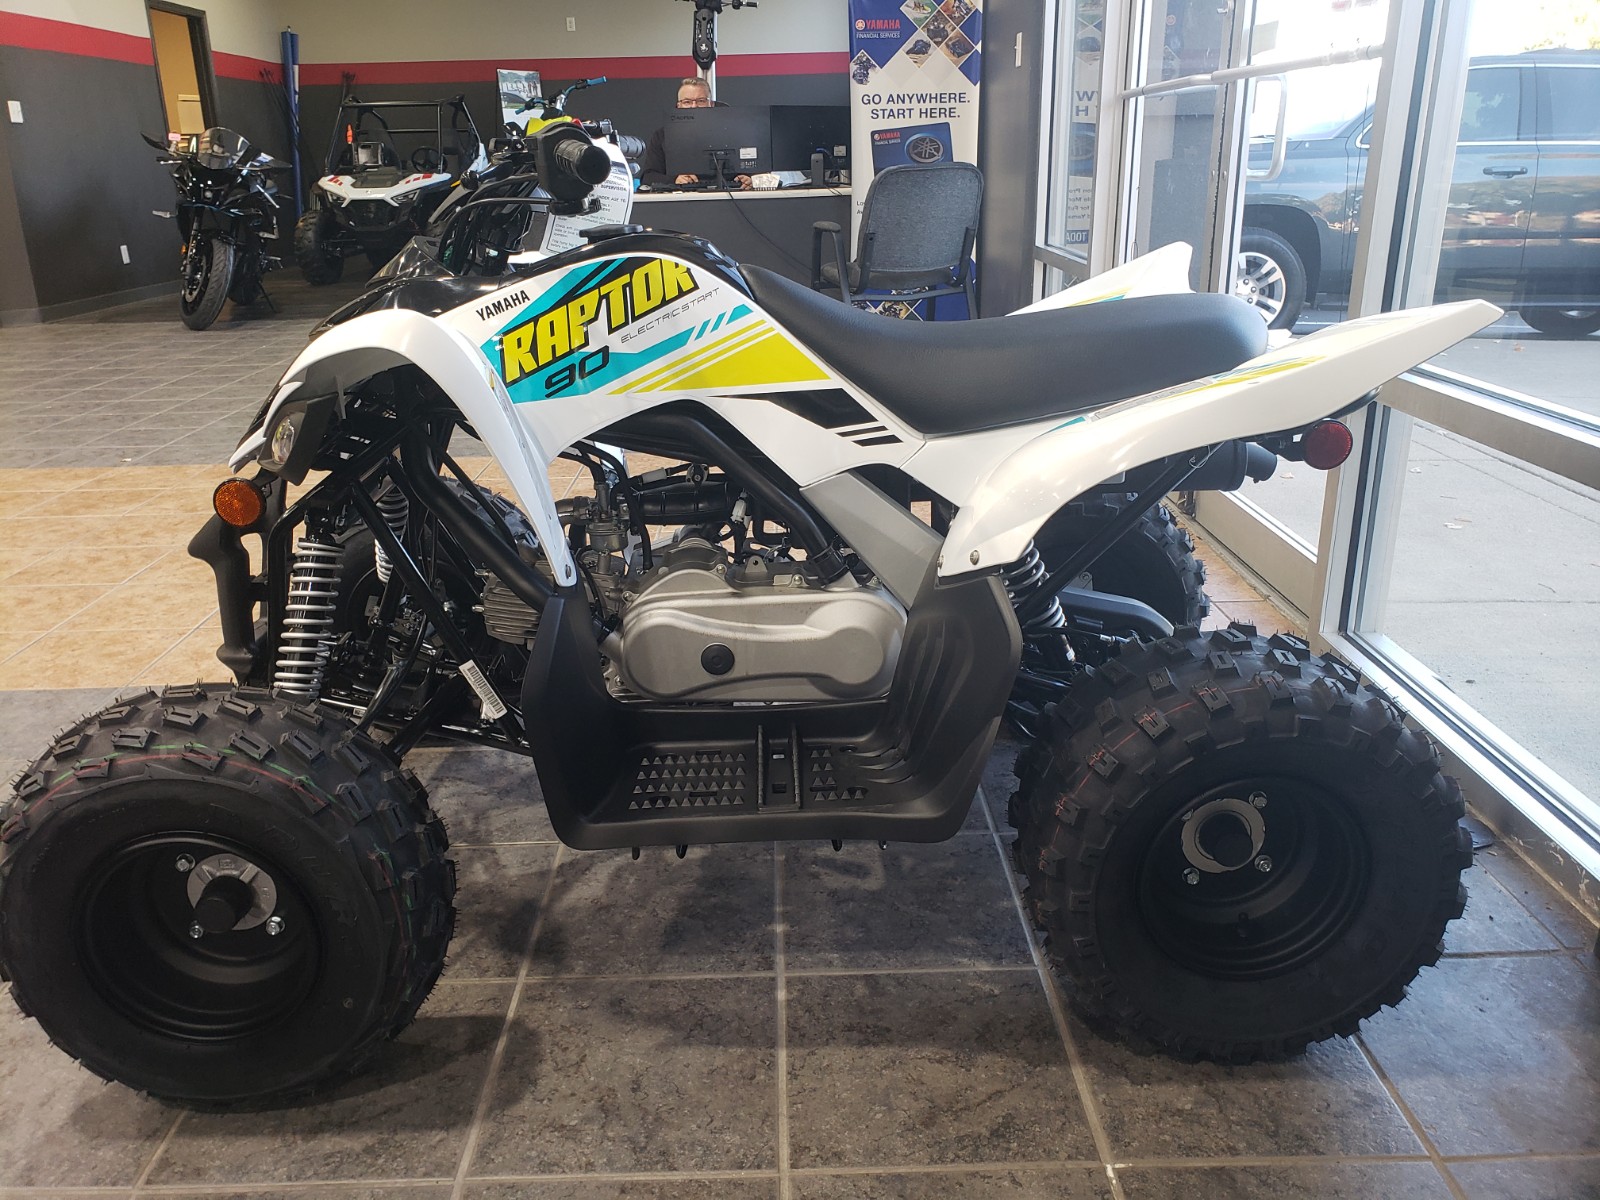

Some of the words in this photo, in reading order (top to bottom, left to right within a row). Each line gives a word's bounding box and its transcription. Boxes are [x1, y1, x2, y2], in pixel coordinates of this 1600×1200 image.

[866, 19, 900, 29] YAMAHA
[861, 94, 882, 105] GO
[886, 92, 970, 104] ANYWHERE.
[870, 108, 914, 120] START
[919, 107, 960, 118] HERE.
[476, 290, 531, 321] YAMAHA
[501, 258, 697, 385] RAPTOR
[544, 345, 610, 398] 90
